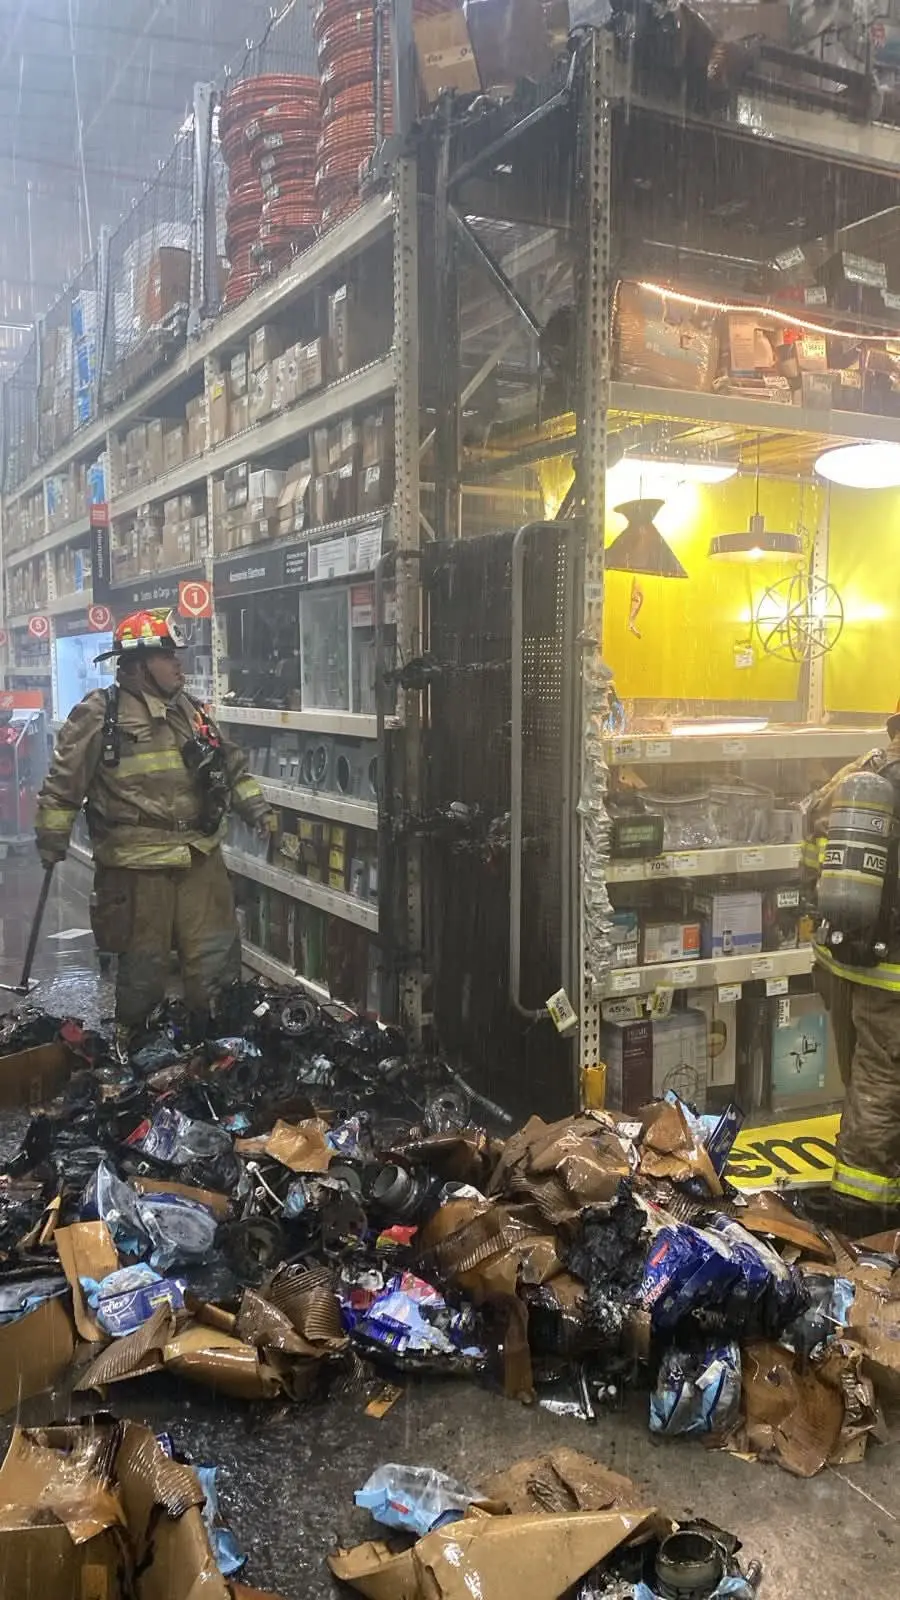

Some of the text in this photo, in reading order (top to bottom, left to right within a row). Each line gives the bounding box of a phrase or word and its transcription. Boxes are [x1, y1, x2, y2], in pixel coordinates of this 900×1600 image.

[191, 592, 199, 604] 1
[96, 610, 104, 620] 3
[608, 1006, 631, 1014] 45%
